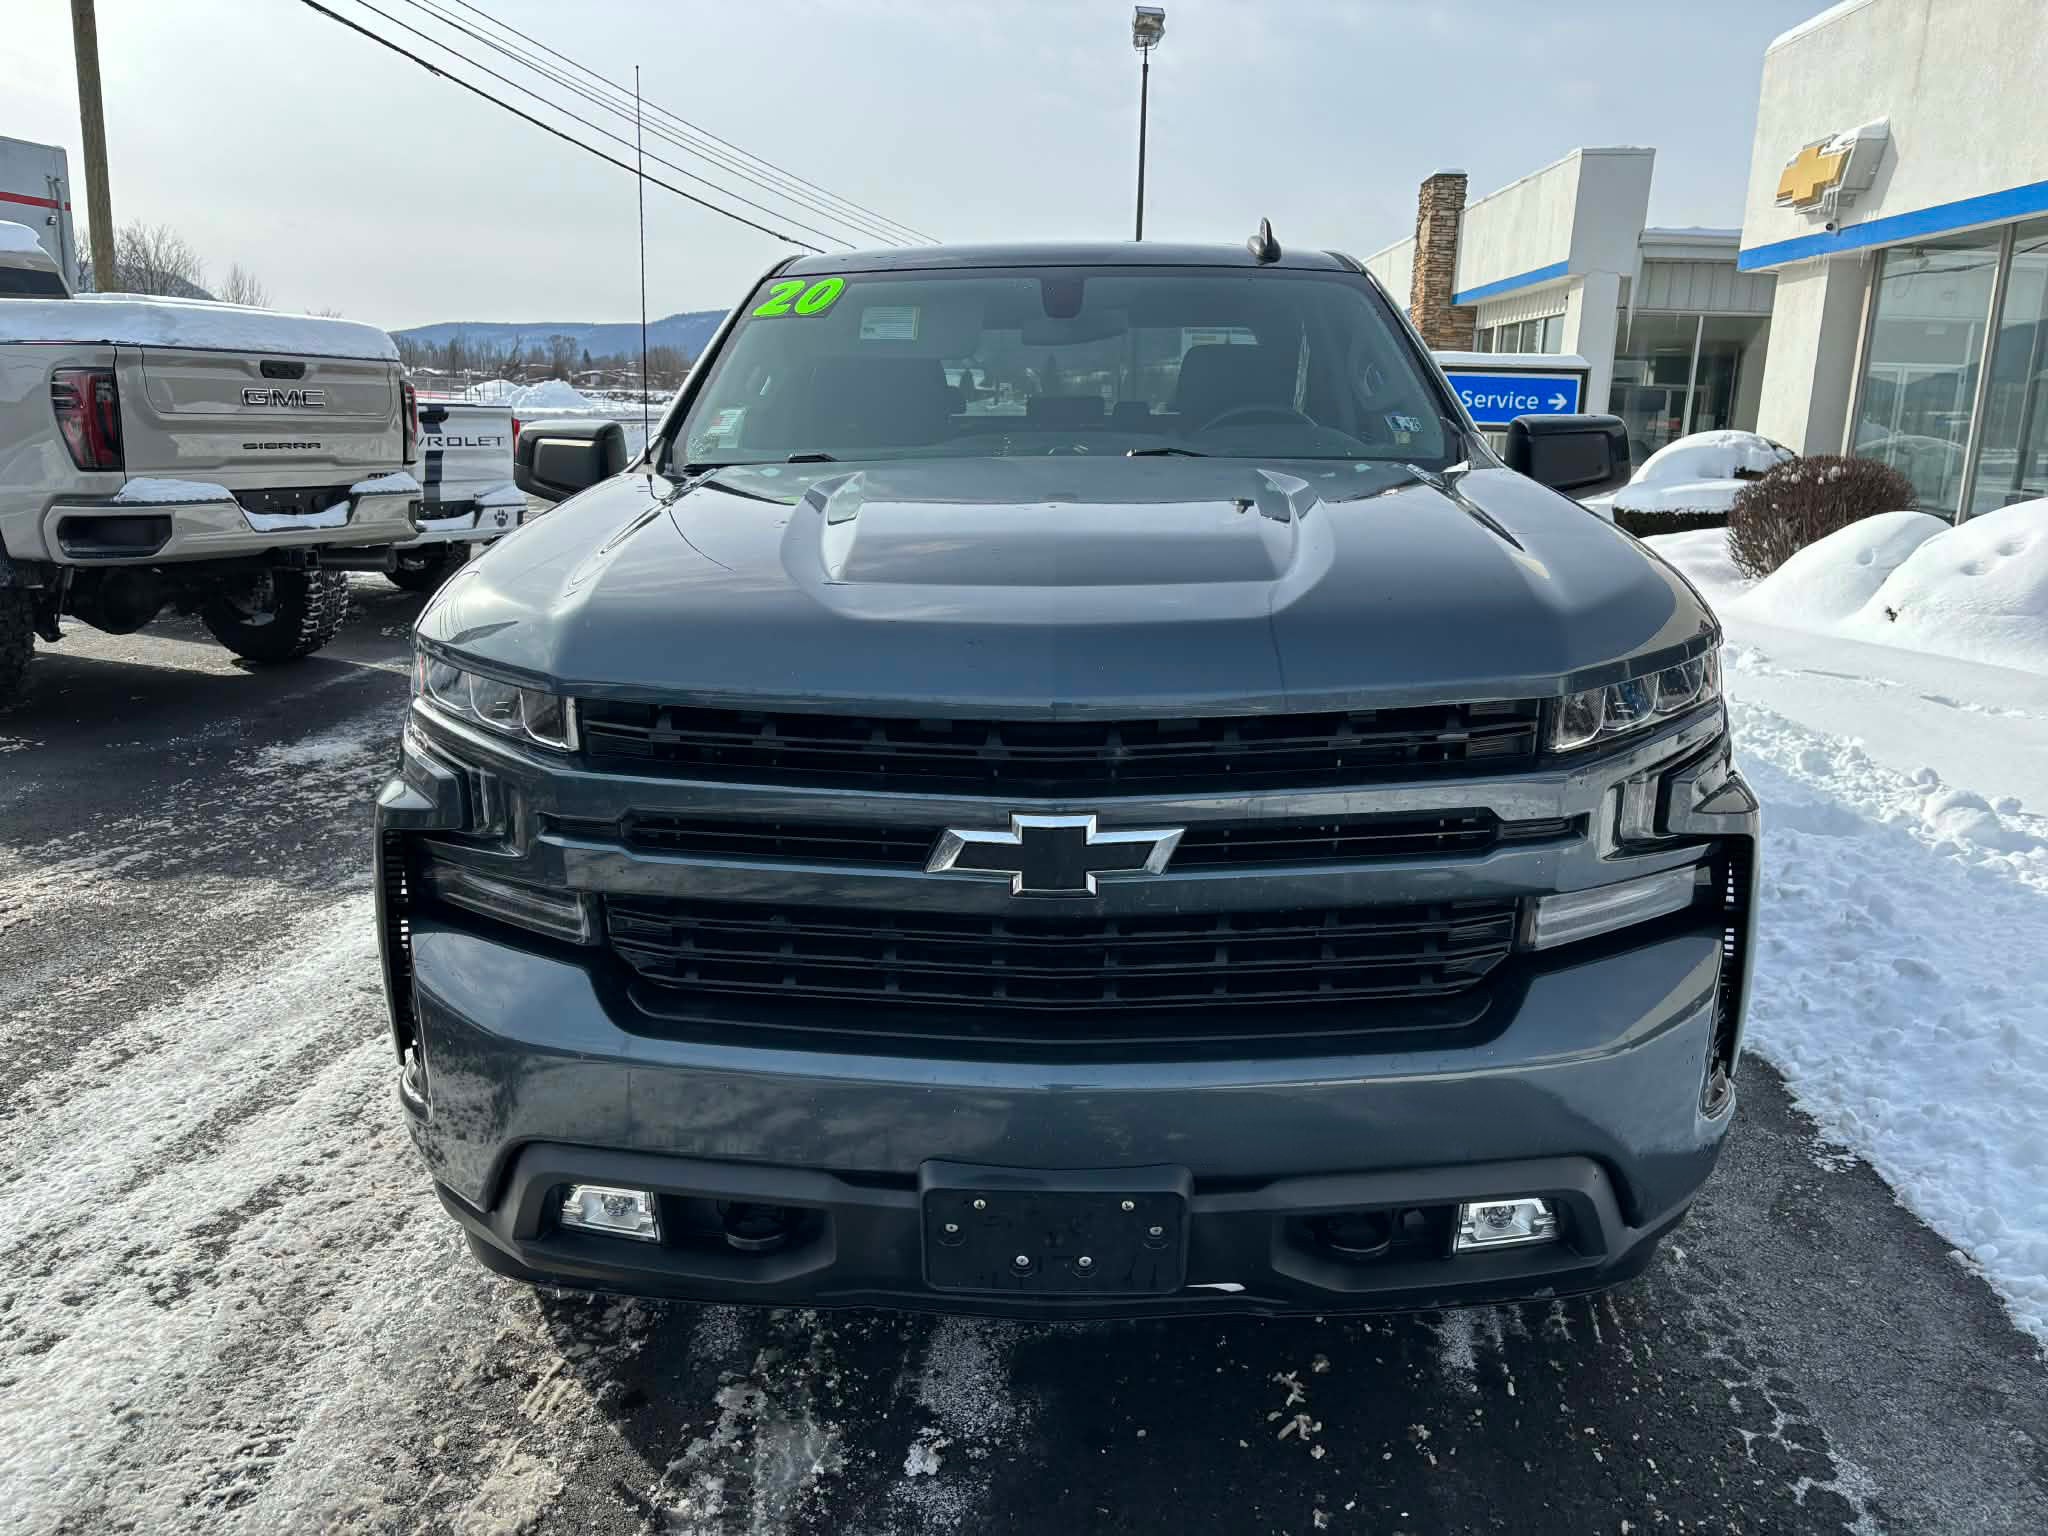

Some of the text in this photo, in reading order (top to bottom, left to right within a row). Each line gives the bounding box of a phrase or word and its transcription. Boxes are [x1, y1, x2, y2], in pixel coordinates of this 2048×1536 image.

[752, 277, 846, 317] 20
[242, 387, 326, 408] GMC
[1461, 390, 1539, 410] Service
